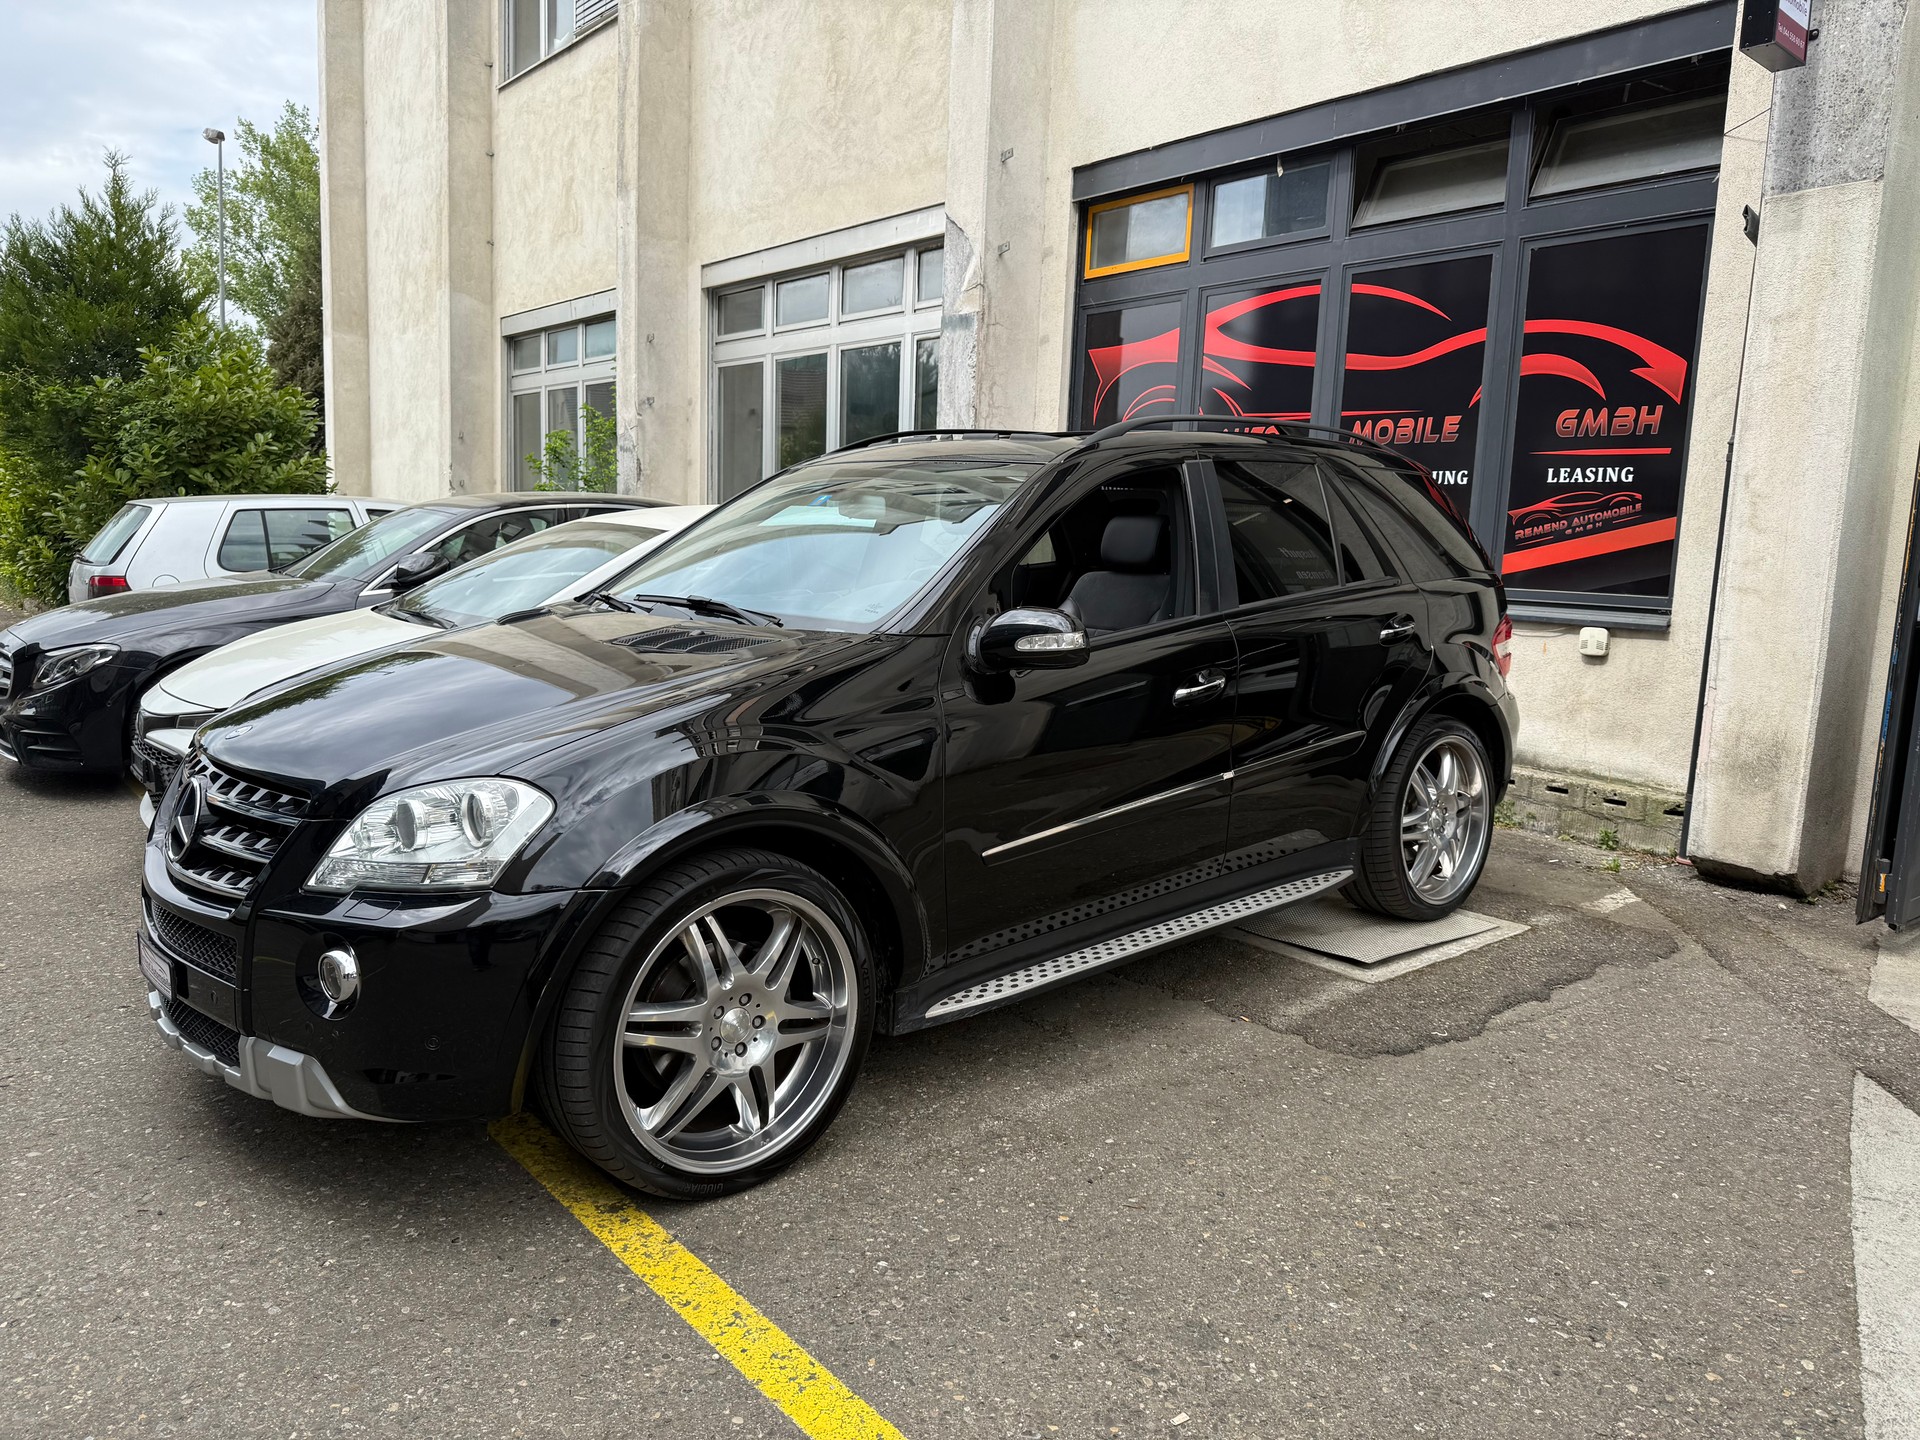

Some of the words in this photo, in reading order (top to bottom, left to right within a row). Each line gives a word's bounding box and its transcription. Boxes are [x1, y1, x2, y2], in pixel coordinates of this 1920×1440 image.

[1555, 405, 1664, 438] GMBH
[1547, 467, 1635, 483] LEASING
[1515, 520, 1568, 540] REMEND
[1571, 503, 1642, 527] AUTOMOBILE
[1565, 522, 1602, 535] GMBH
